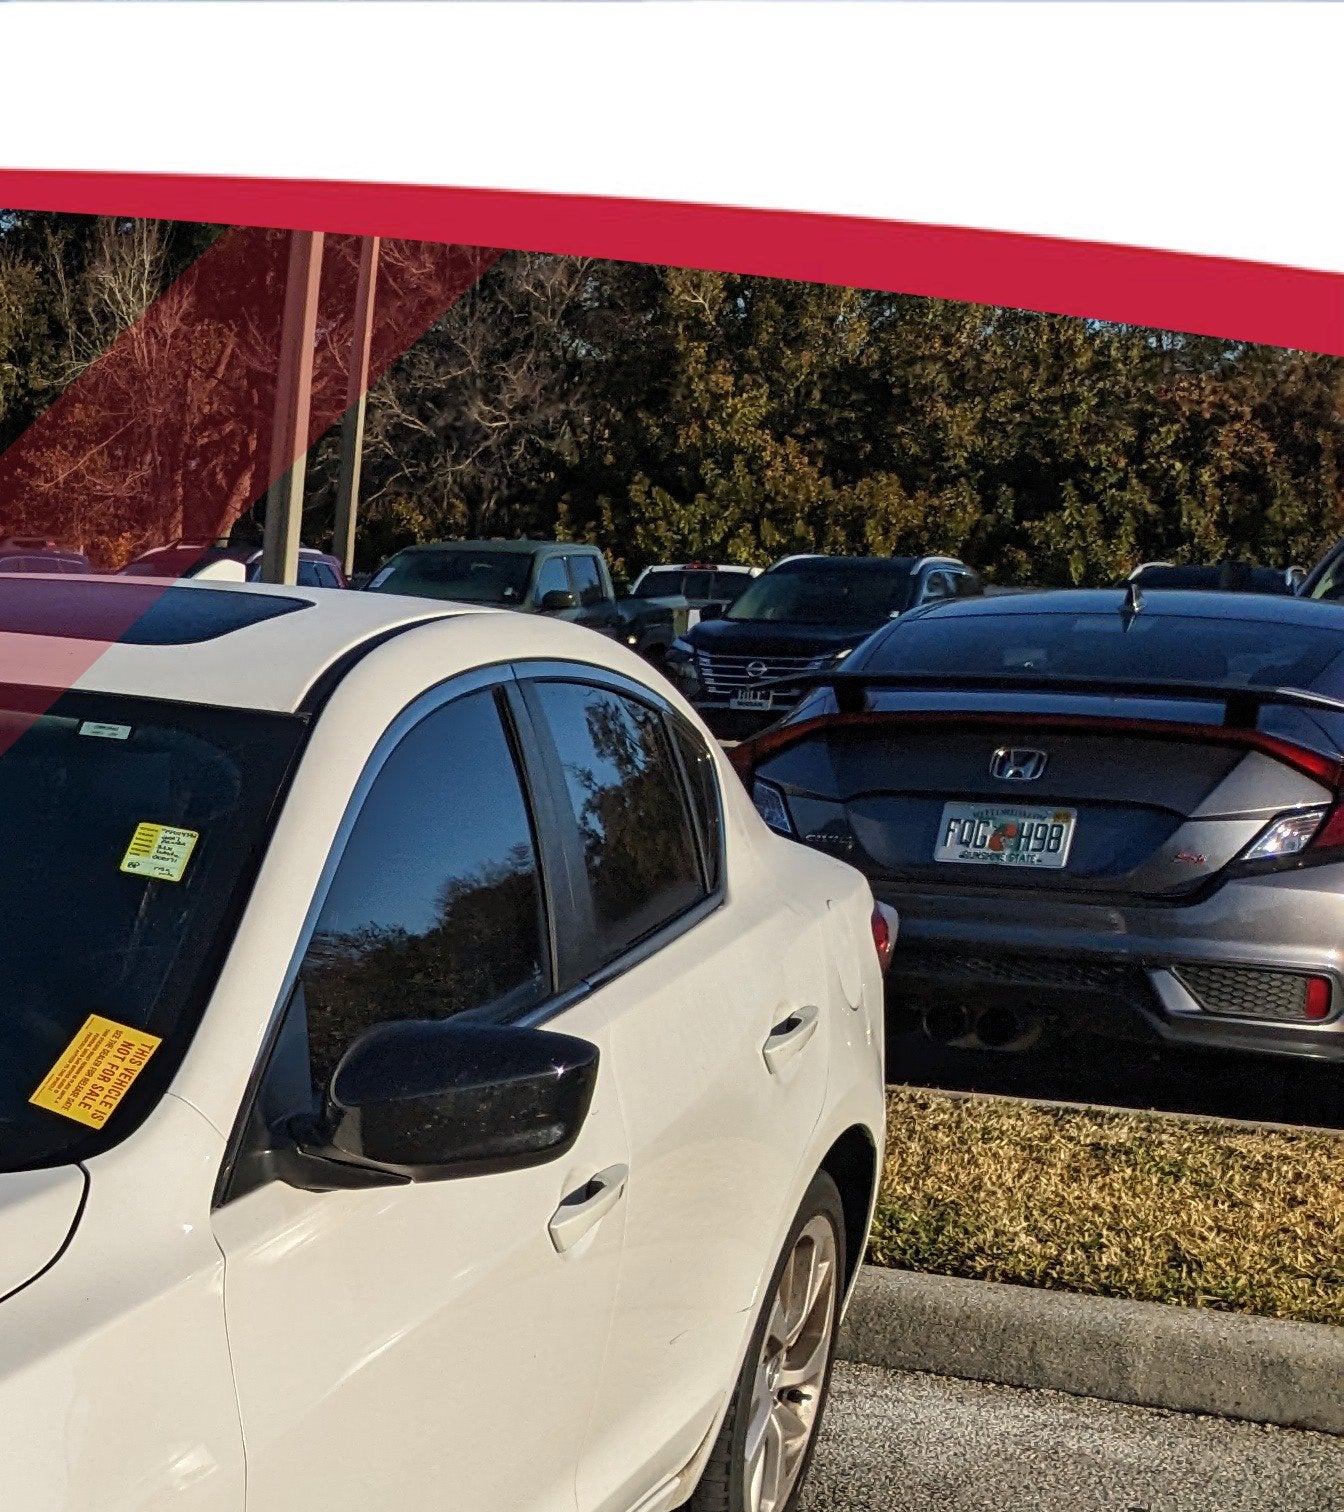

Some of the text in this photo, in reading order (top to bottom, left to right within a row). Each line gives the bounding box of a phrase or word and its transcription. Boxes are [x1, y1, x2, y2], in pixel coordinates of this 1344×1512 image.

[112, 1040, 136, 1063] NOT
[61, 1029, 124, 1111] SEE THE DEALER FOR RELEASE DATE
[91, 1043, 155, 1121] THIS VEHICLE IS
[97, 1062, 120, 1083] FOR
[77, 1083, 105, 1110] SALE
